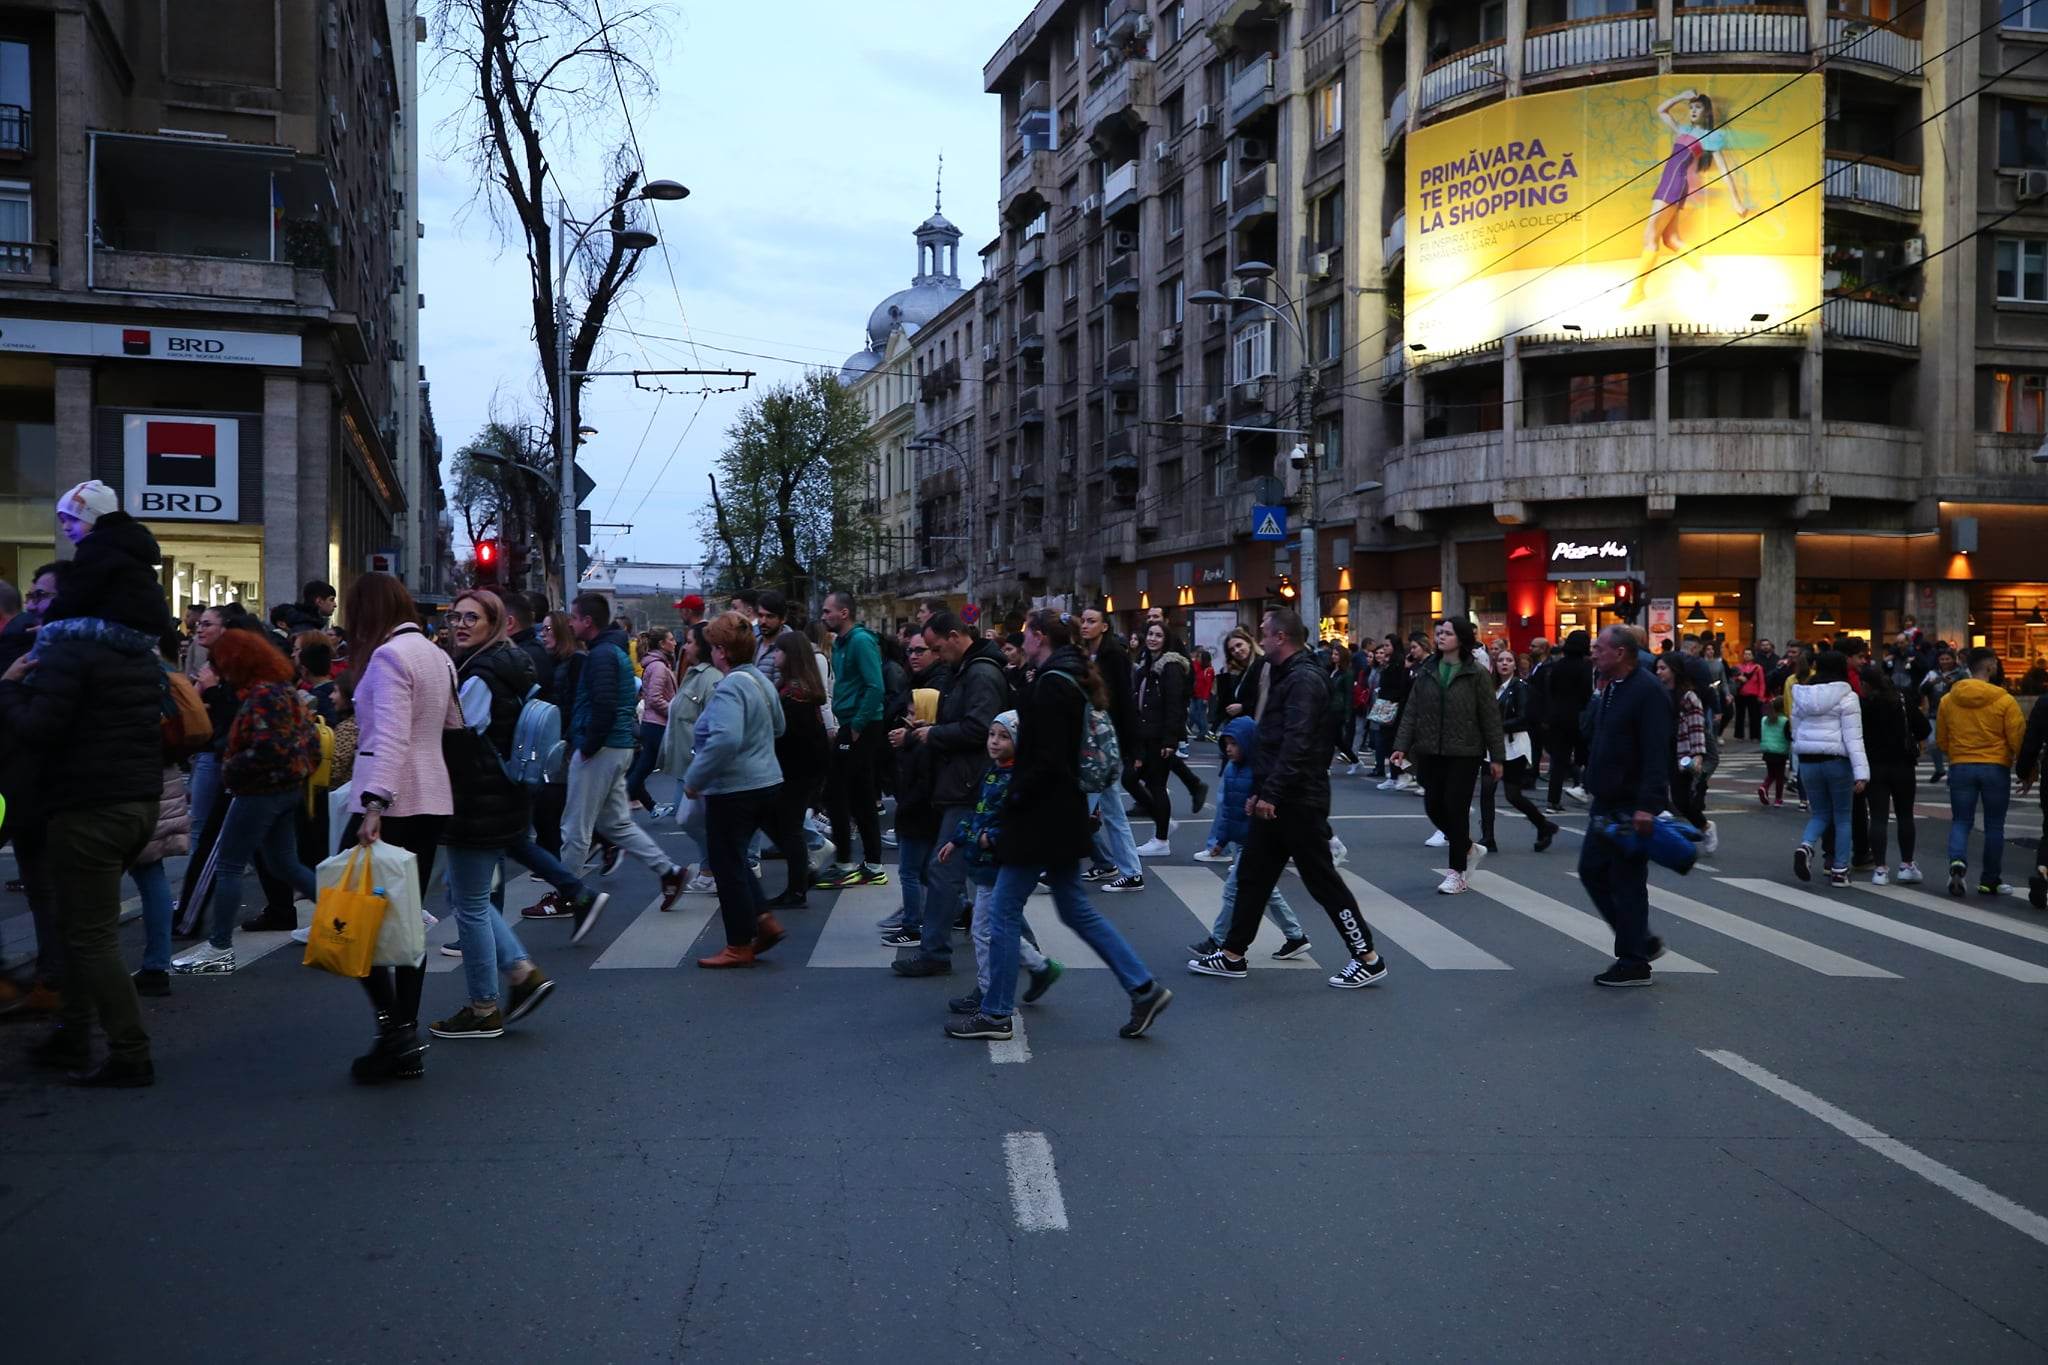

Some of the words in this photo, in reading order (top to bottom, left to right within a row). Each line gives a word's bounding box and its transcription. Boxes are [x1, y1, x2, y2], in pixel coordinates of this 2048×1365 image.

[1420, 139, 1547, 190] PRIMĂVARA
[1420, 188, 1443, 211] TE
[1448, 152, 1579, 204] PROVOACĂ
[1420, 211, 1445, 235] LA
[1449, 183, 1569, 226] SHOPPING
[168, 337, 225, 353] BRD
[142, 493, 222, 513] BRD
[1552, 542, 1599, 560] Pizza
[1600, 541, 1628, 558] Hut
